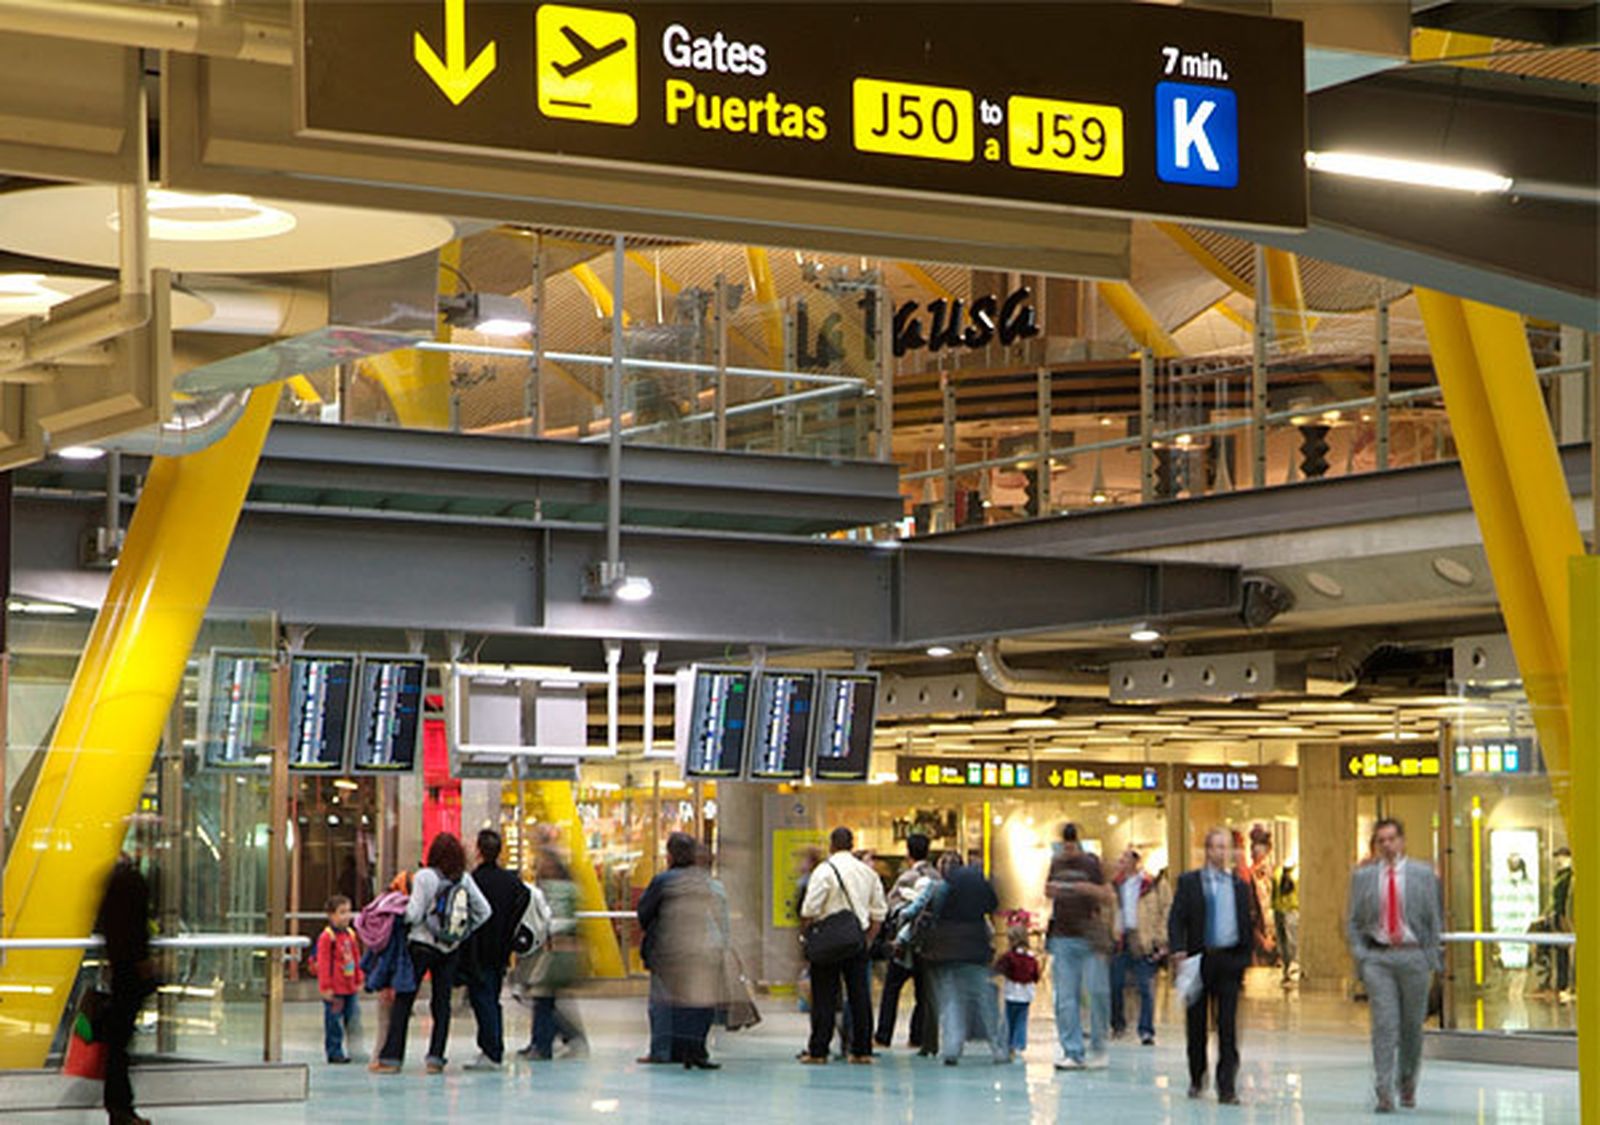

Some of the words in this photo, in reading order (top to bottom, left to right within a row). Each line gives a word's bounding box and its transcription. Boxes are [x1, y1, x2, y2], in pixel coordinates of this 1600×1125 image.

[662, 23, 768, 76] Gates
[1162, 46, 1180, 75] 7
[1181, 51, 1230, 81] min.
[666, 78, 827, 141] Puertas
[871, 92, 958, 144] J50
[980, 99, 1003, 126] to
[1027, 111, 1107, 162] J59
[1173, 96, 1221, 172] K
[983, 137, 1001, 161] a
